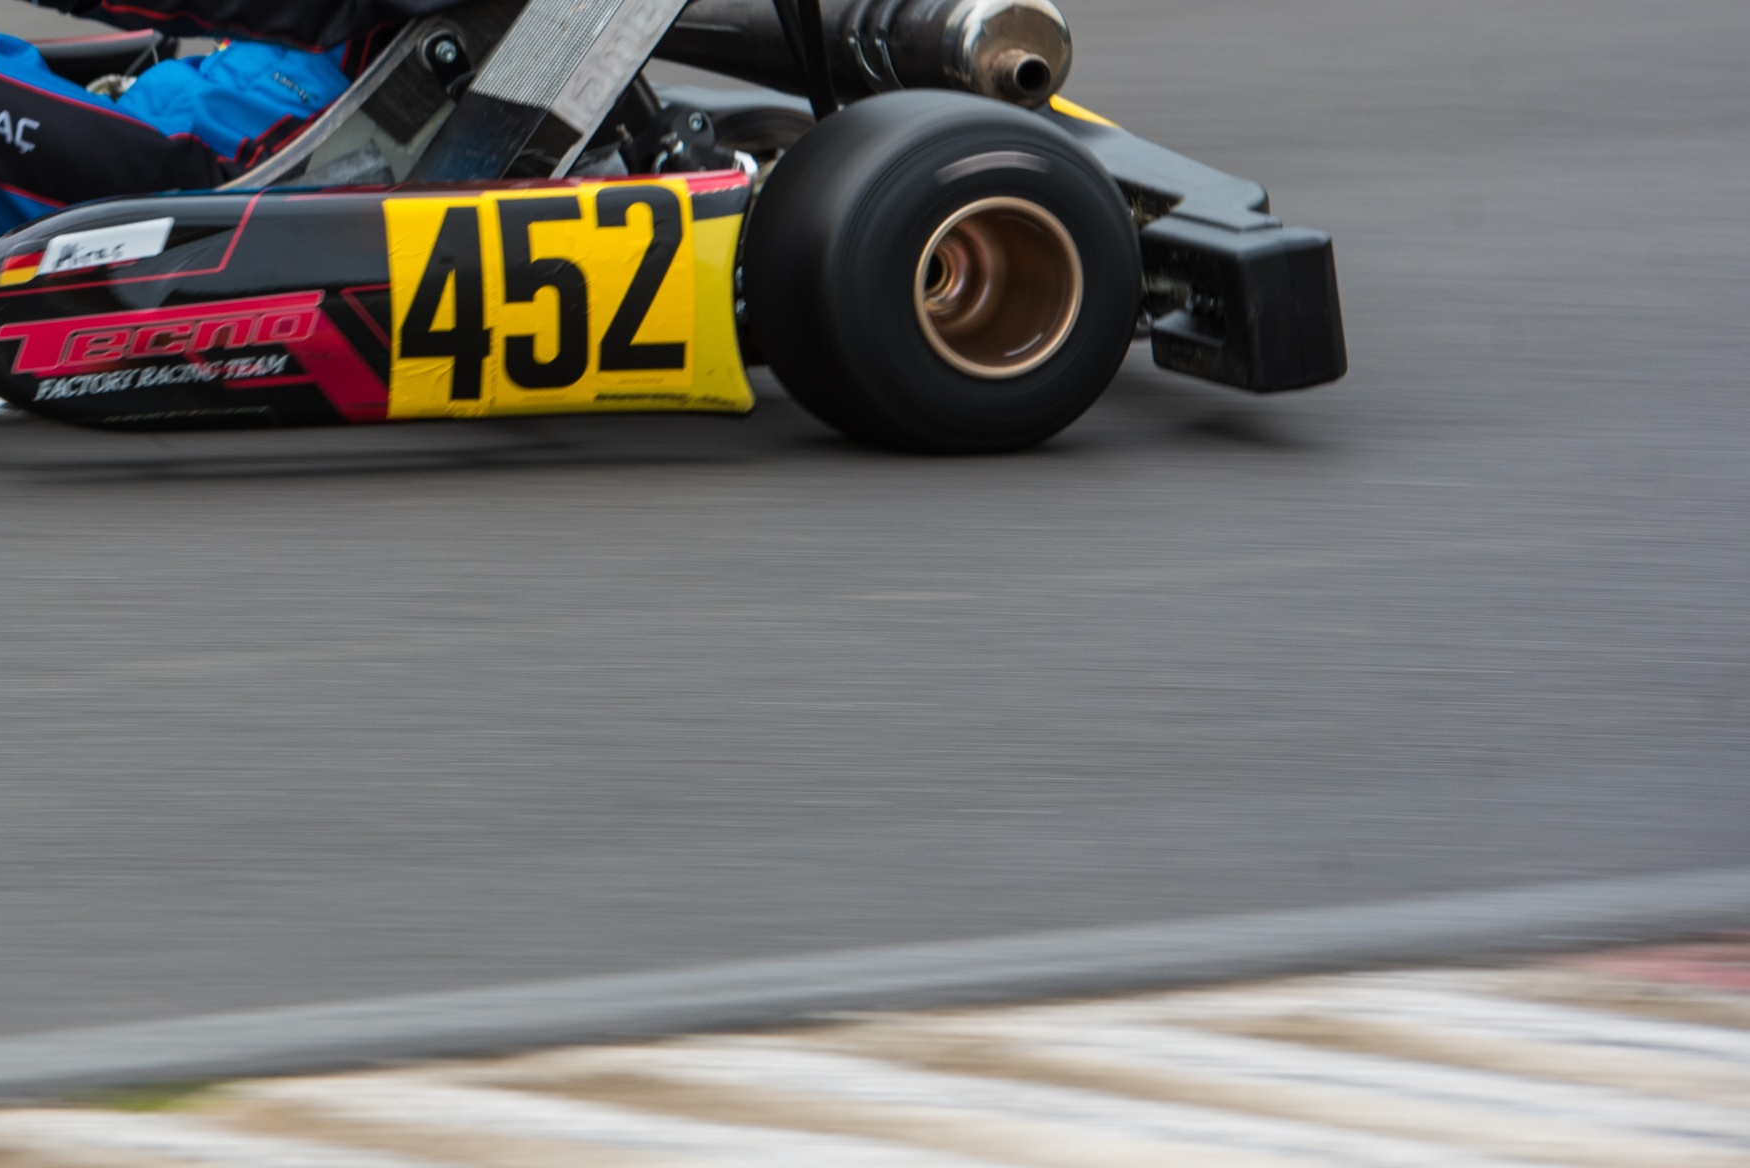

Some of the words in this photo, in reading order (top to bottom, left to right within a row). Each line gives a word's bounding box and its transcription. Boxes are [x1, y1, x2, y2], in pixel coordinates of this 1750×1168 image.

[400, 185, 687, 400] 452
[32, 368, 142, 402] FACTORY
[134, 359, 224, 389] RACING
[222, 353, 290, 380] TEAM
